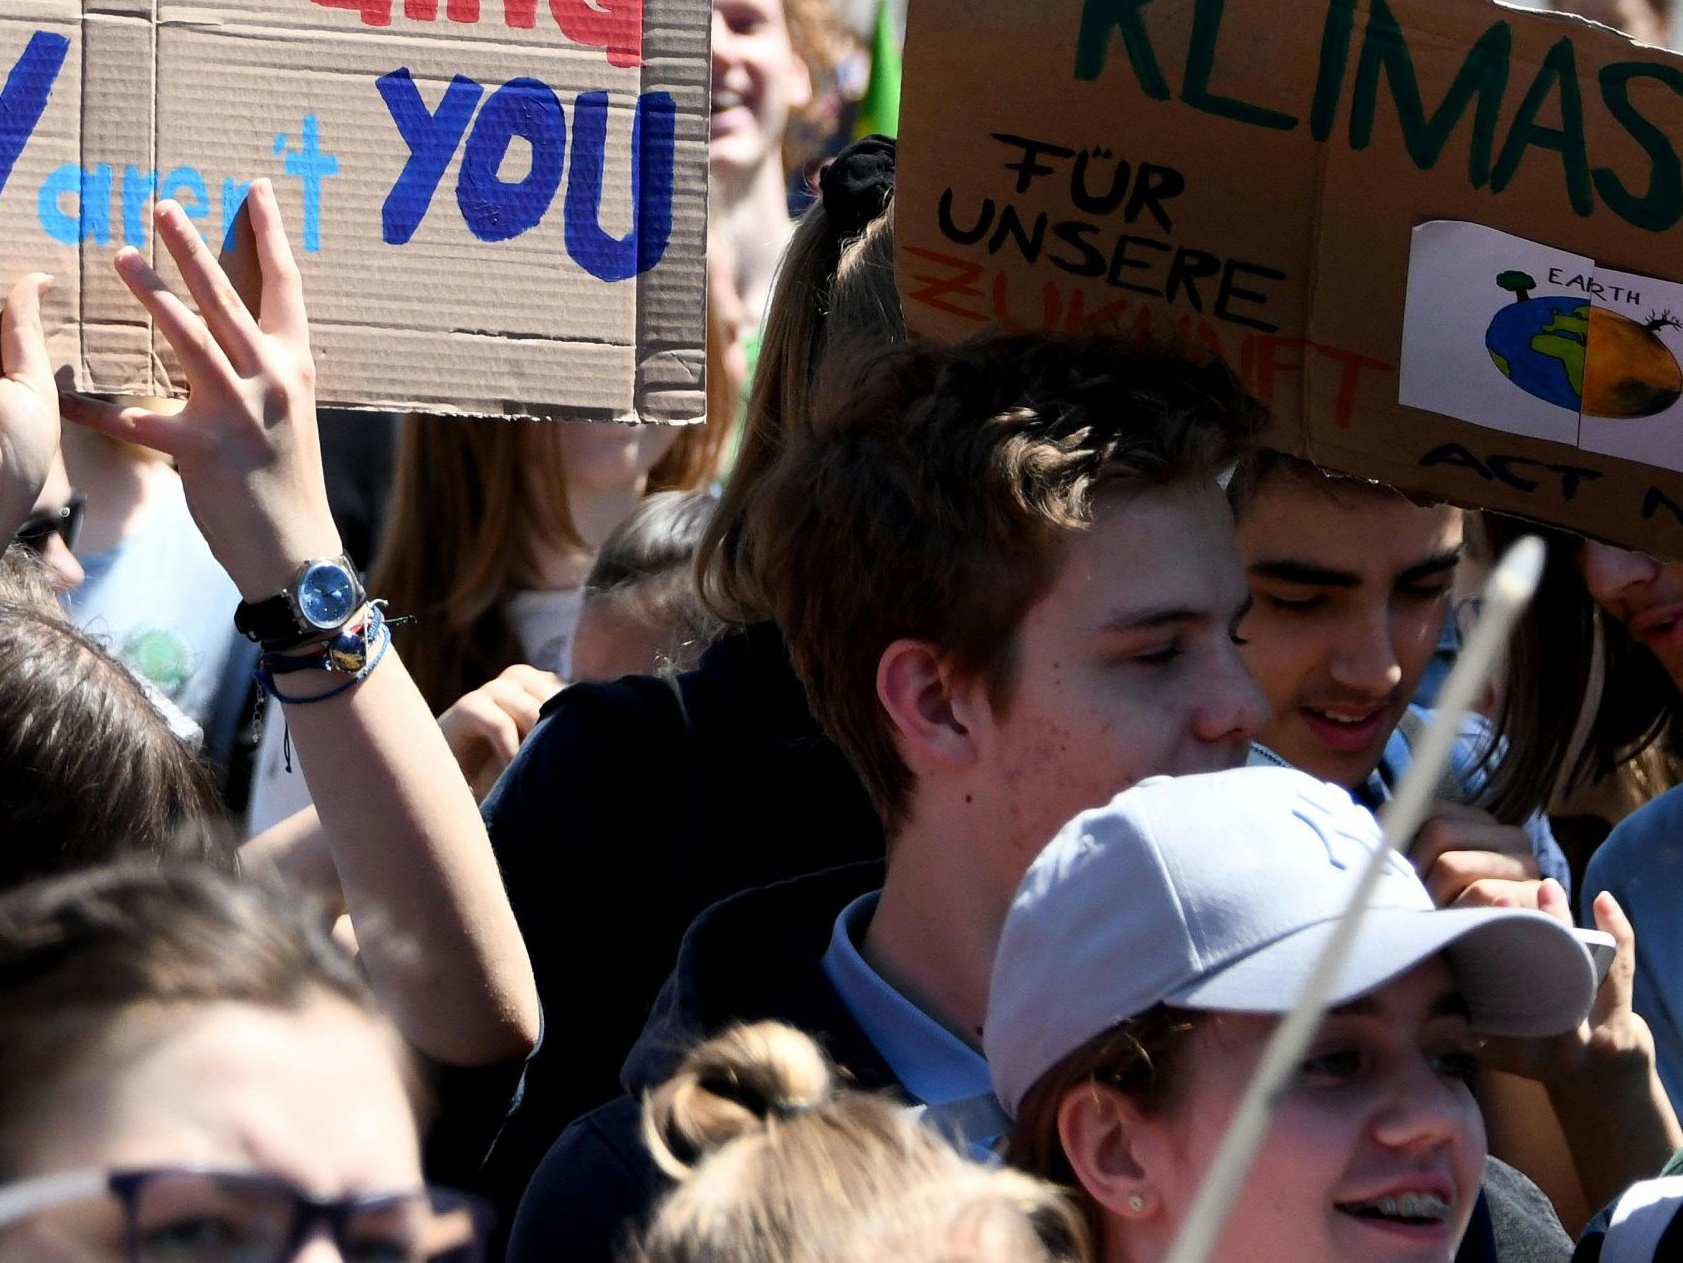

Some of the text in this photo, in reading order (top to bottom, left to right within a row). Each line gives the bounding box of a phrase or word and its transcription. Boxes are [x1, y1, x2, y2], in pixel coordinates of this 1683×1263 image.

[375, 68, 676, 282] YOU
[989, 132, 1185, 233] FÜR
[937, 187, 1287, 333] UNSERE
[1547, 267, 1641, 305] EARTH
[1419, 442, 1604, 501] ACT
